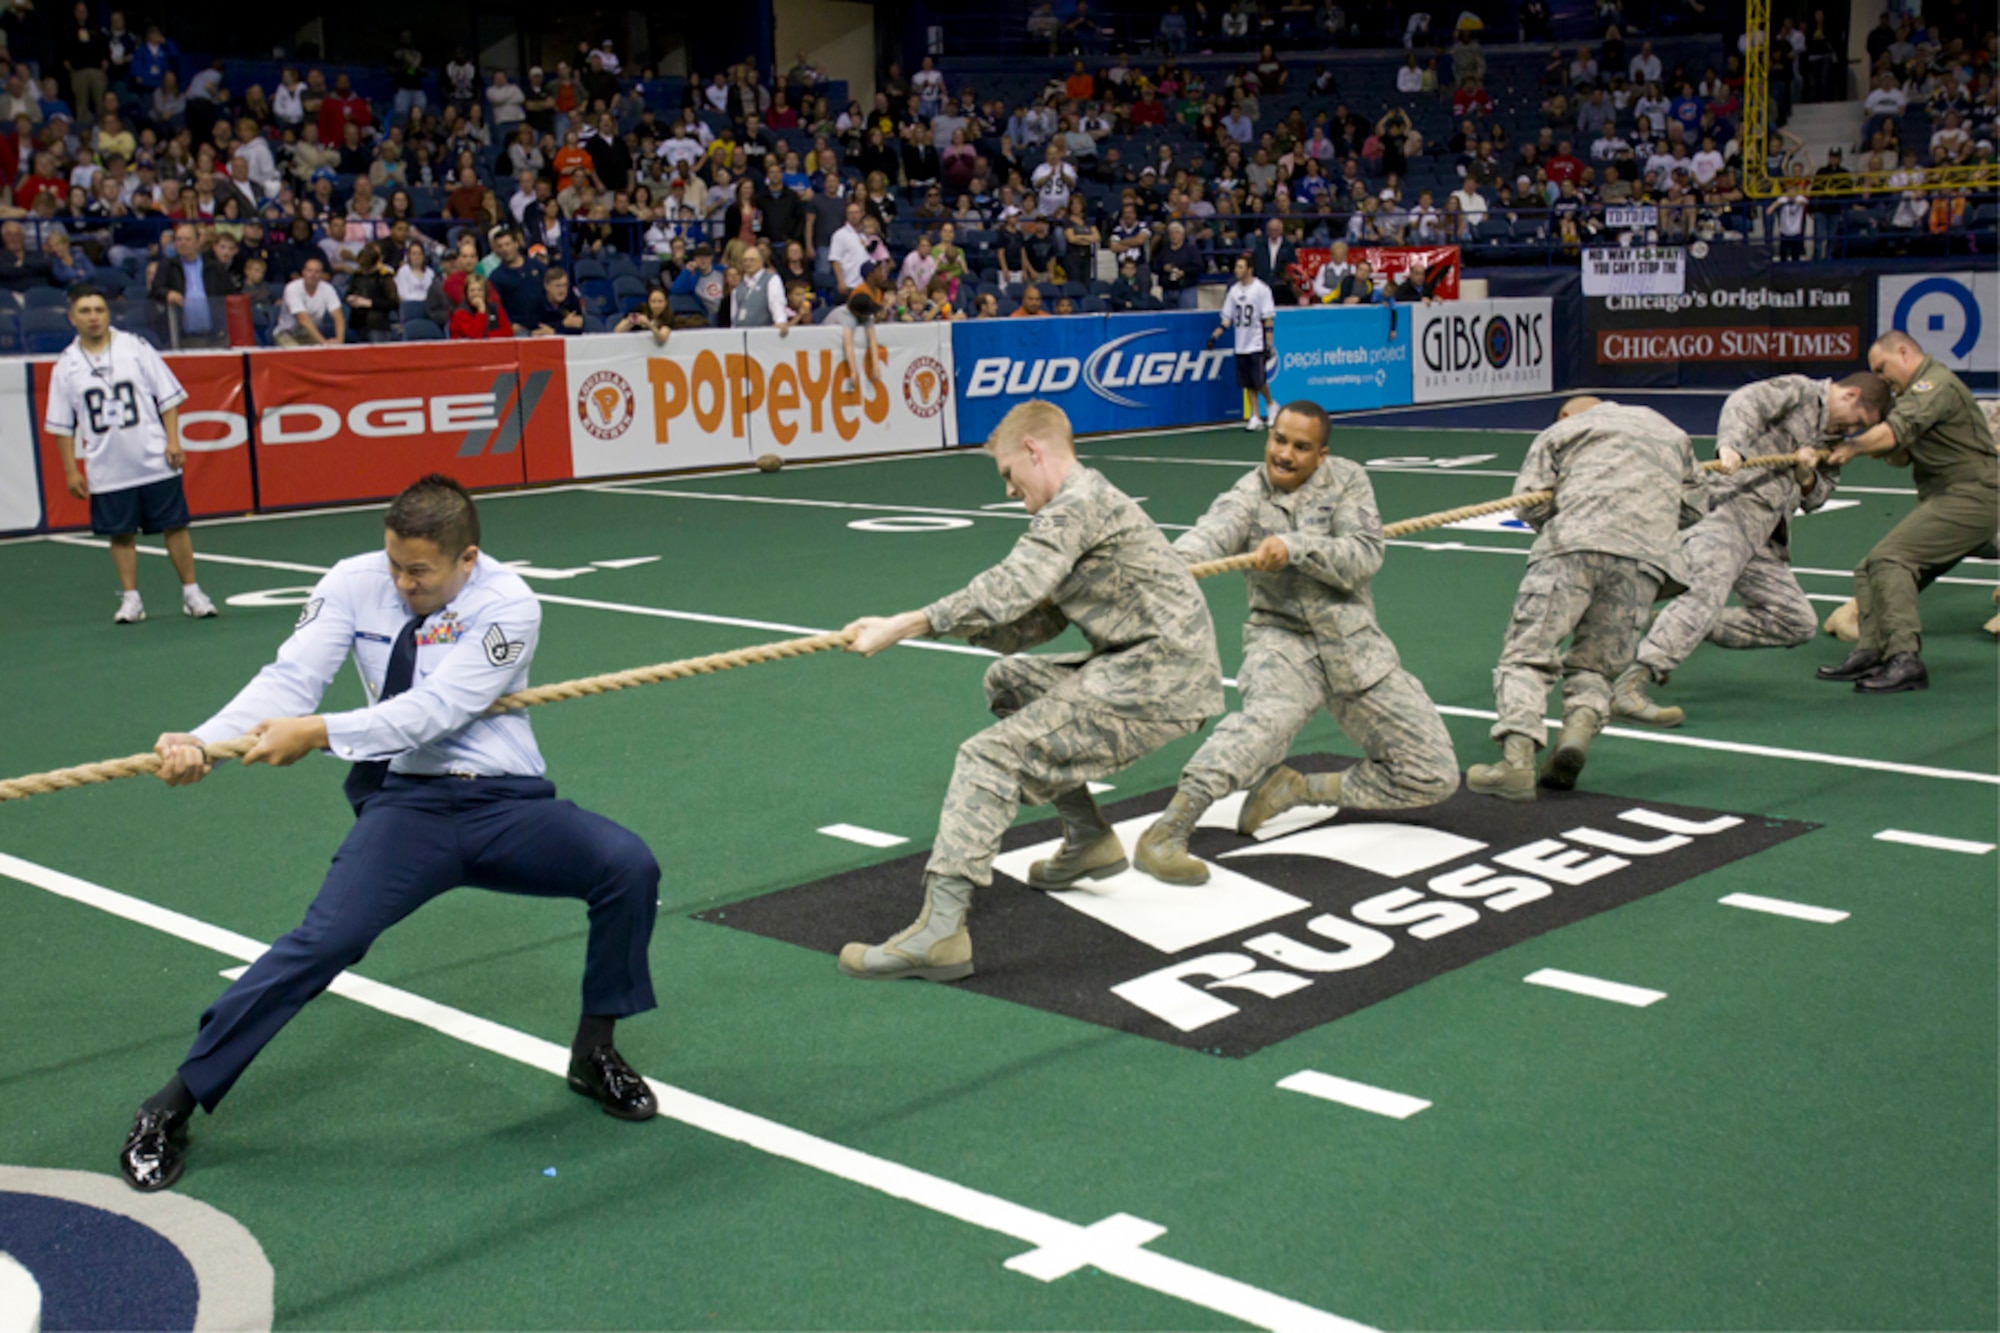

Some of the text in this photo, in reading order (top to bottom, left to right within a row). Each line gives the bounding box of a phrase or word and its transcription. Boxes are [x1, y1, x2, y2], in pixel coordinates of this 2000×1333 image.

[1589, 248, 1604, 260] NO
[1608, 248, 1631, 260] WAY
[1593, 262, 1609, 274] YOU
[1638, 262, 1659, 274] STOP
[1662, 262, 1677, 274] THE
[1605, 287, 1849, 313] Chicago's Original Fan
[1422, 313, 1543, 372] GIBSONS
[1603, 331, 1851, 359] CHICAGO SUN-TIMES
[1284, 344, 1406, 371] pepsi refresh project
[966, 349, 1236, 398] BUD LIGHT
[75, 392, 499, 460] ODGE
[1110, 807, 1745, 1032] RUSSELL
